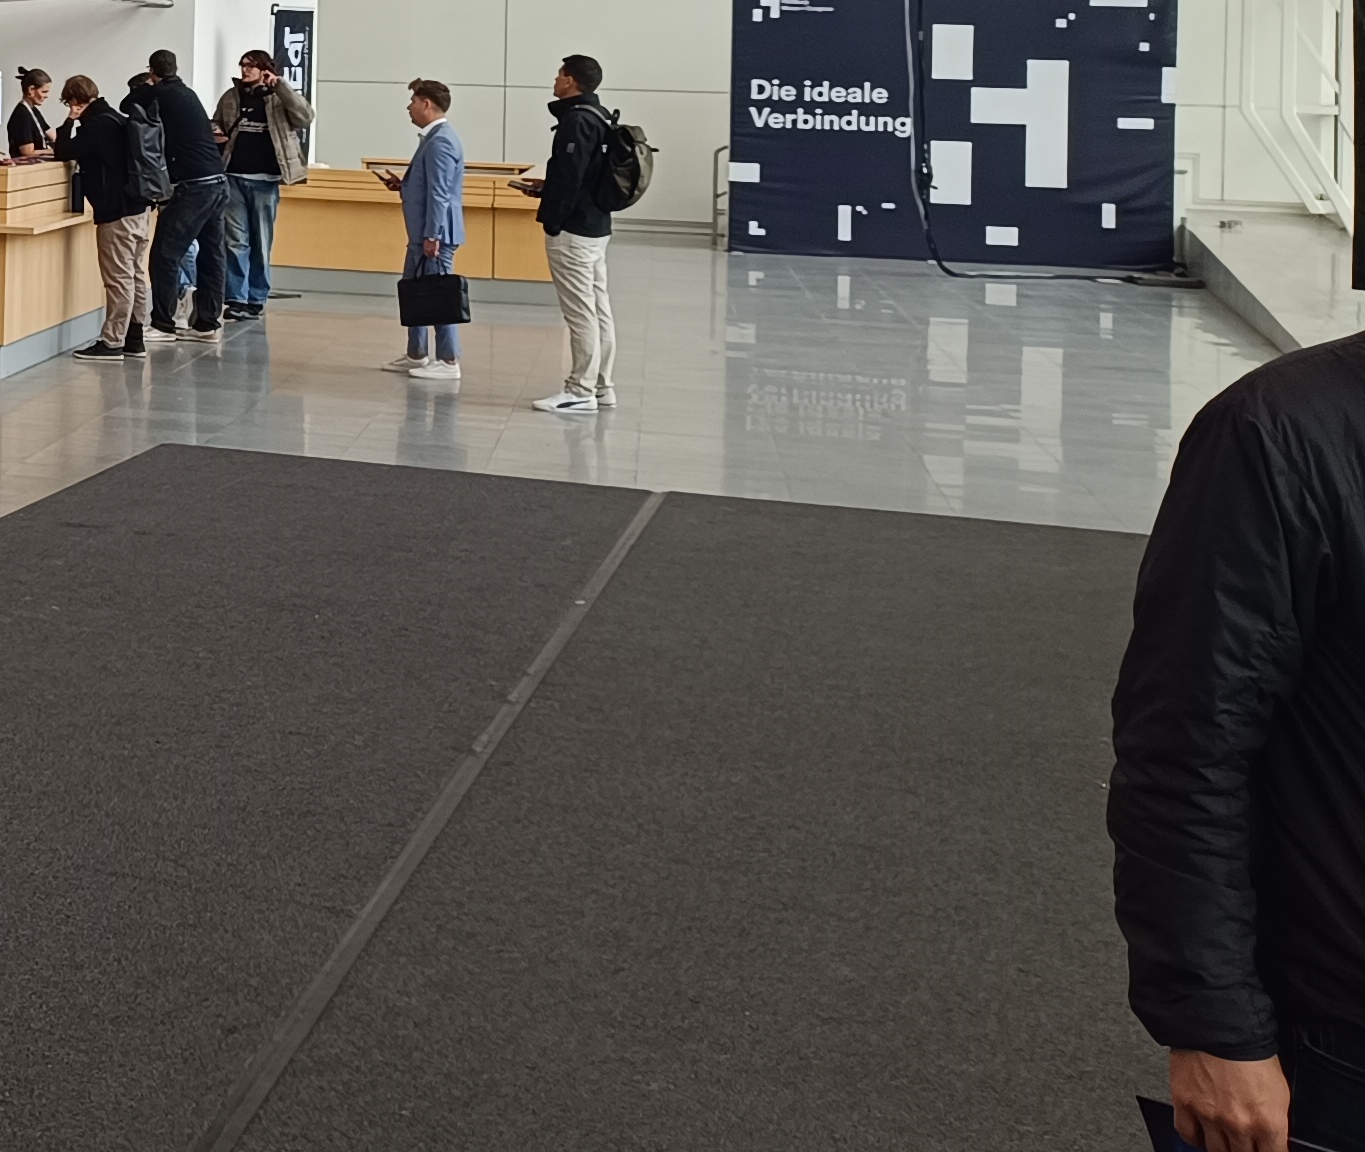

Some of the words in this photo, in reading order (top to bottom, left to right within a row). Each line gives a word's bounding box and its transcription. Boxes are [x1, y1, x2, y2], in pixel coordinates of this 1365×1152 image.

[282, 26, 305, 95] EaT
[750, 78, 797, 101] Die
[803, 80, 889, 104] ideale
[748, 106, 912, 138] Verbindung
